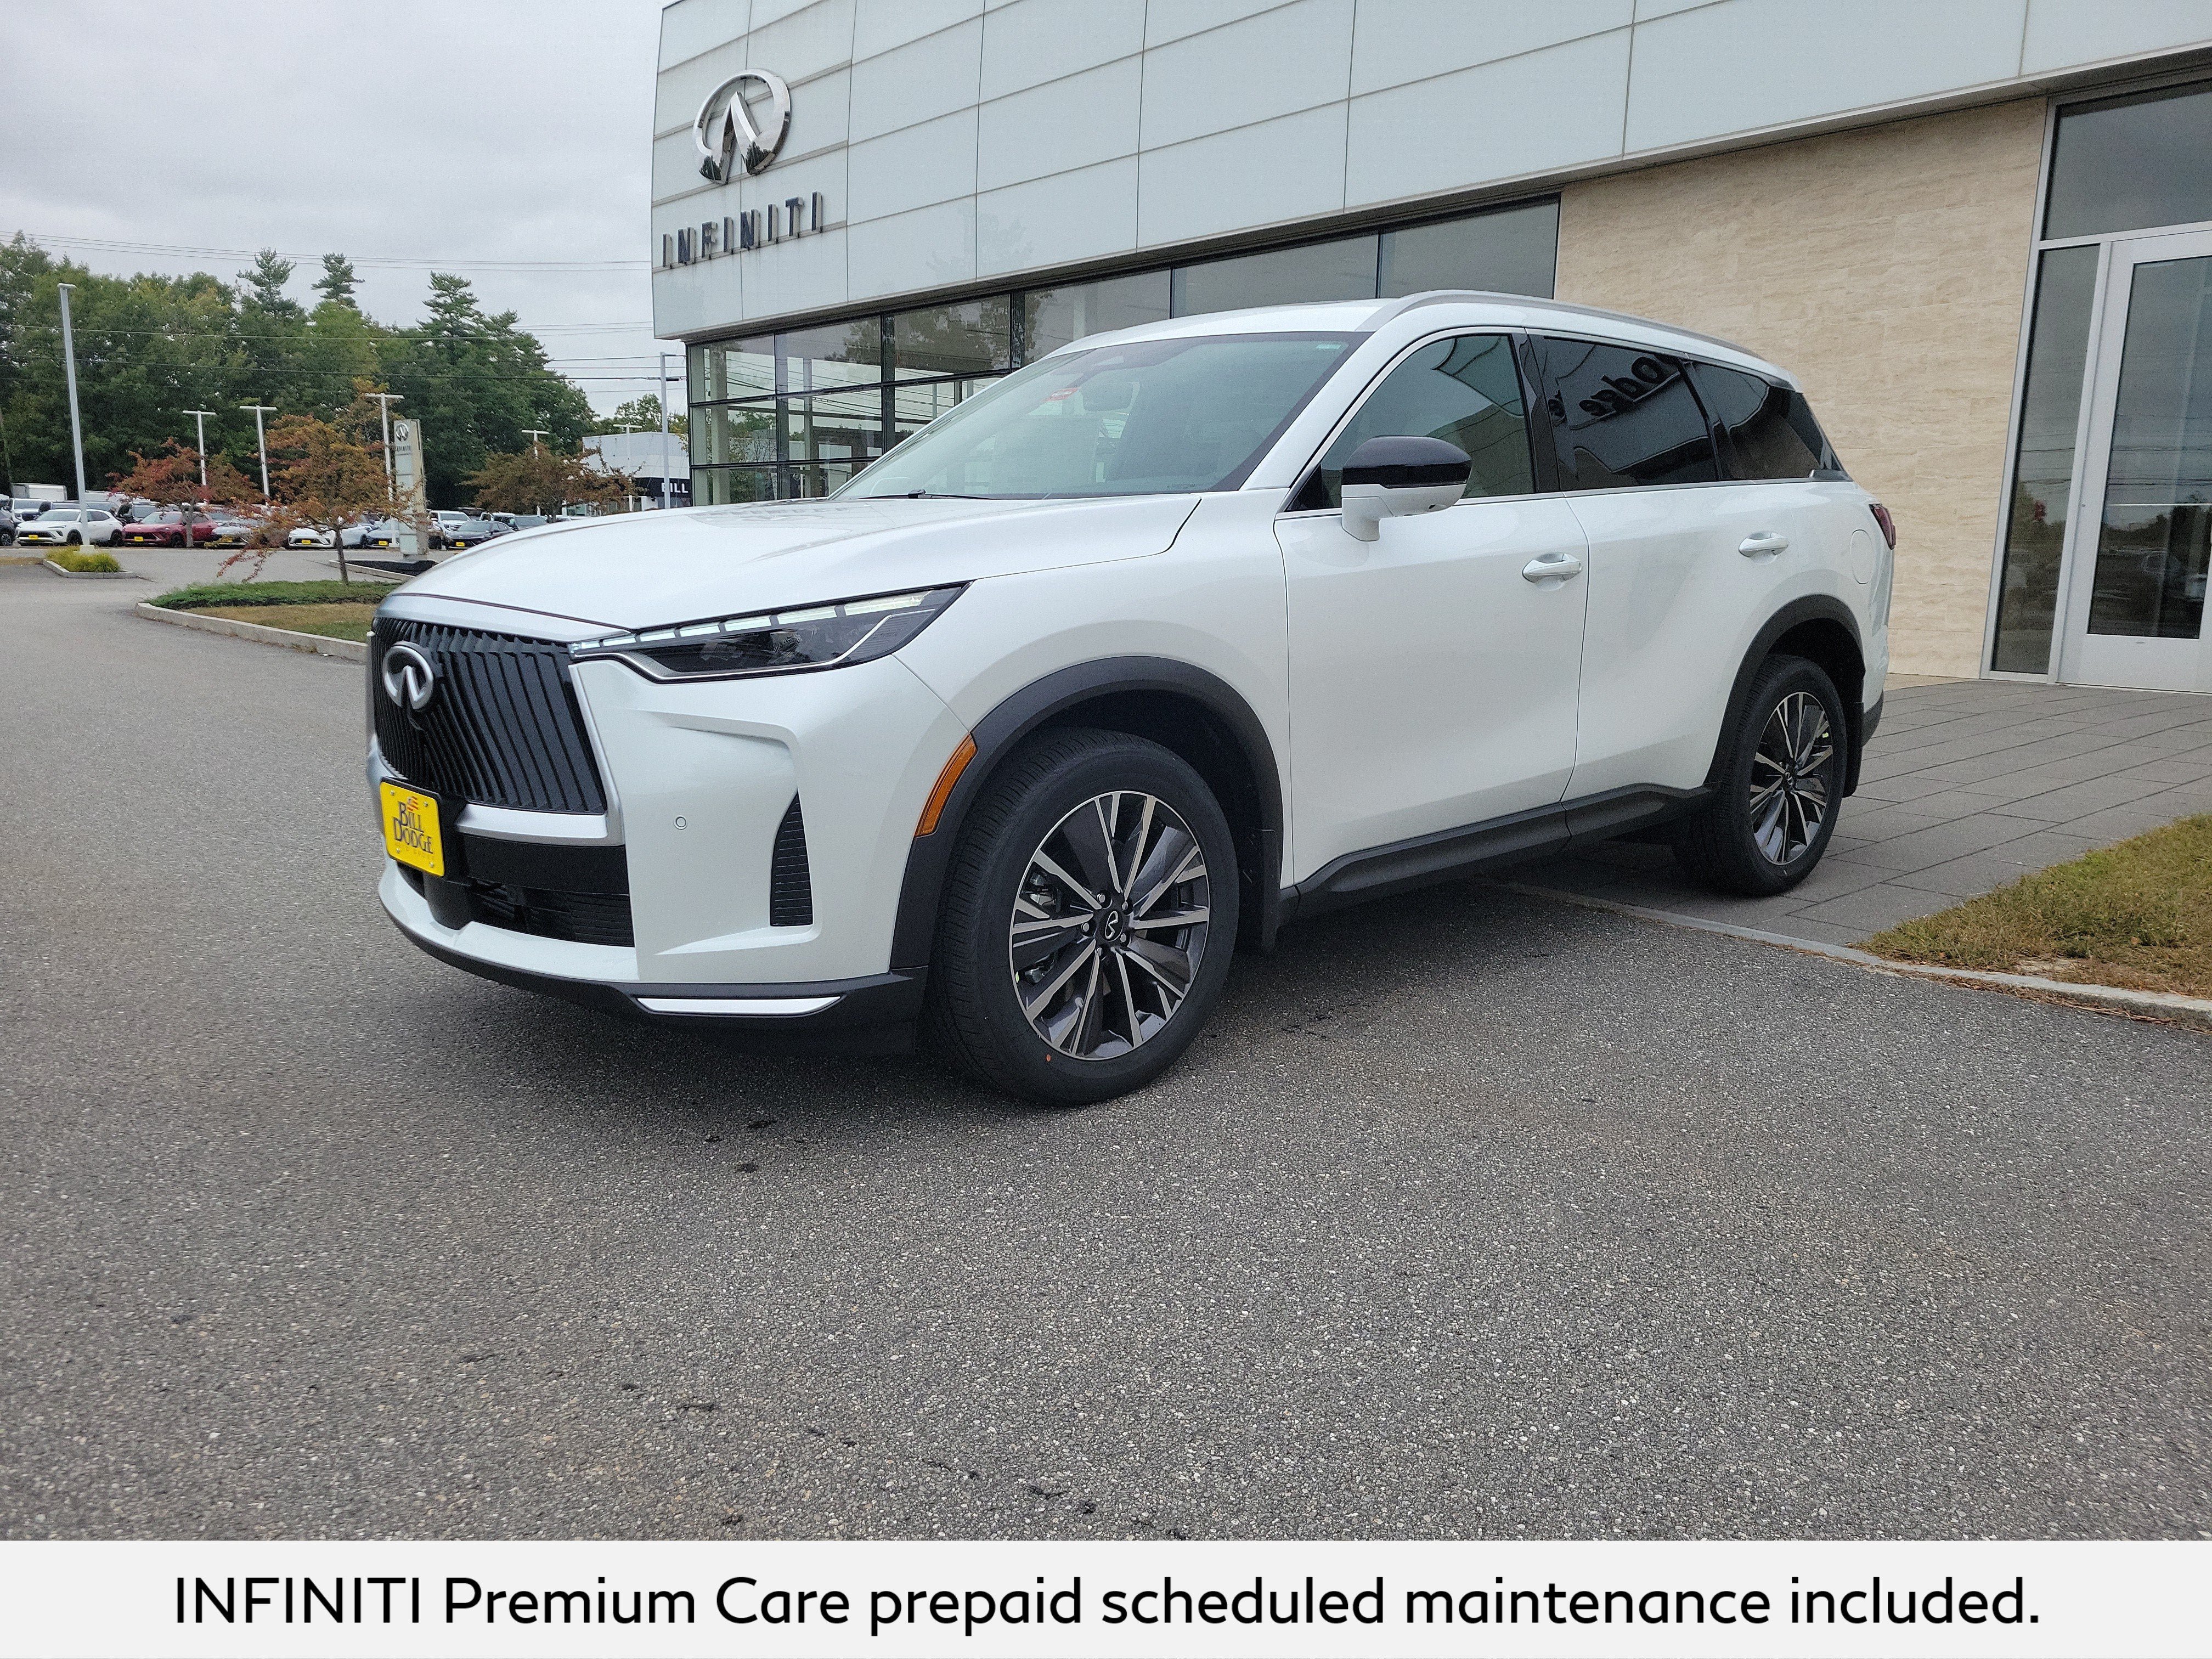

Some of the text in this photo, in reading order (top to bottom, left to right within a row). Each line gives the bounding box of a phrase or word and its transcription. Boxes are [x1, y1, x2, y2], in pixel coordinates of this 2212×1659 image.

[662, 191, 823, 268] INFINITI
[393, 816, 433, 854] DODGE
[398, 801, 424, 833] BILL
